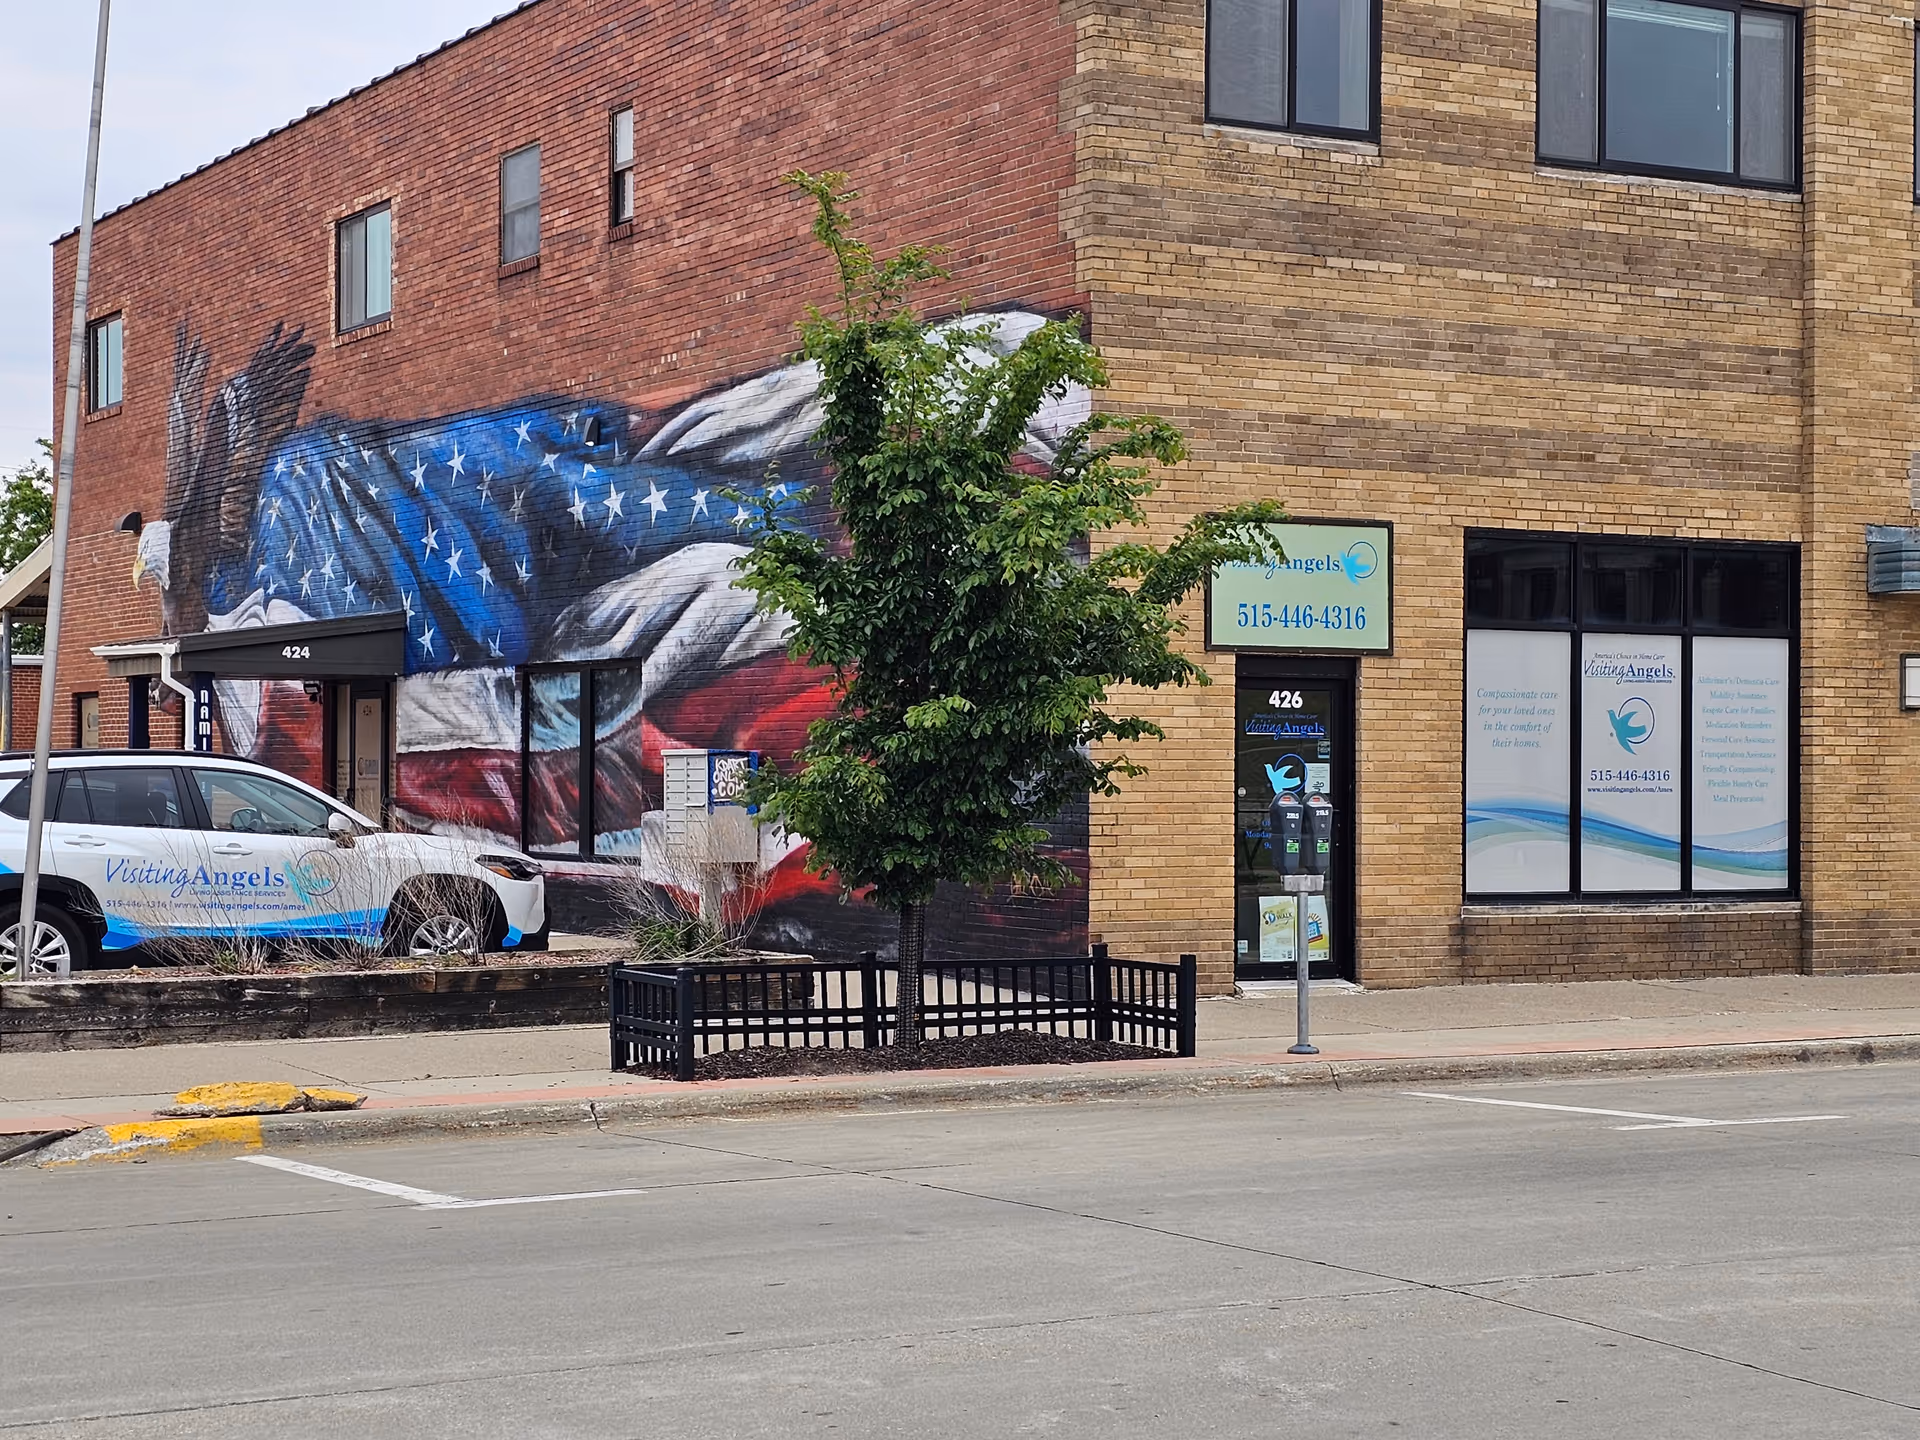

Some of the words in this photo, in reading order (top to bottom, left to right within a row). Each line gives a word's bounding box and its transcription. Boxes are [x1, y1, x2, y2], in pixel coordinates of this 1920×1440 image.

[1238, 603, 1366, 630] 515-446-4316
[282, 646, 310, 659] 424
[1593, 652, 1615, 660] America's
[1616, 652, 1632, 660] Choice
[1652, 653, 1665, 661] Care
[1584, 660, 1626, 685] Visiting
[1625, 663, 1673, 680] Angels
[1269, 690, 1303, 709] 426
[1476, 688, 1539, 700] Compassionate
[1478, 704, 1491, 716] for
[1492, 707, 1512, 717] your
[1513, 705, 1535, 715] loved
[1245, 719, 1282, 741] Visiting
[1282, 722, 1325, 737] Angels
[1483, 721, 1492, 731] in
[1495, 721, 1508, 731] the
[1510, 721, 1541, 733] comfort
[1543, 722, 1553, 733] of
[1492, 737, 1512, 748] their
[1513, 737, 1541, 748] homes.
[1590, 769, 1670, 781] 515-446-4316
[1587, 785, 1673, 793] www.visitingangels.com/Ames
[106, 858, 191, 898] Visiting
[191, 864, 285, 891] Angels
[254, 890, 286, 898] SERVICES
[174, 901, 306, 912] www.visitingangels.com/ames
